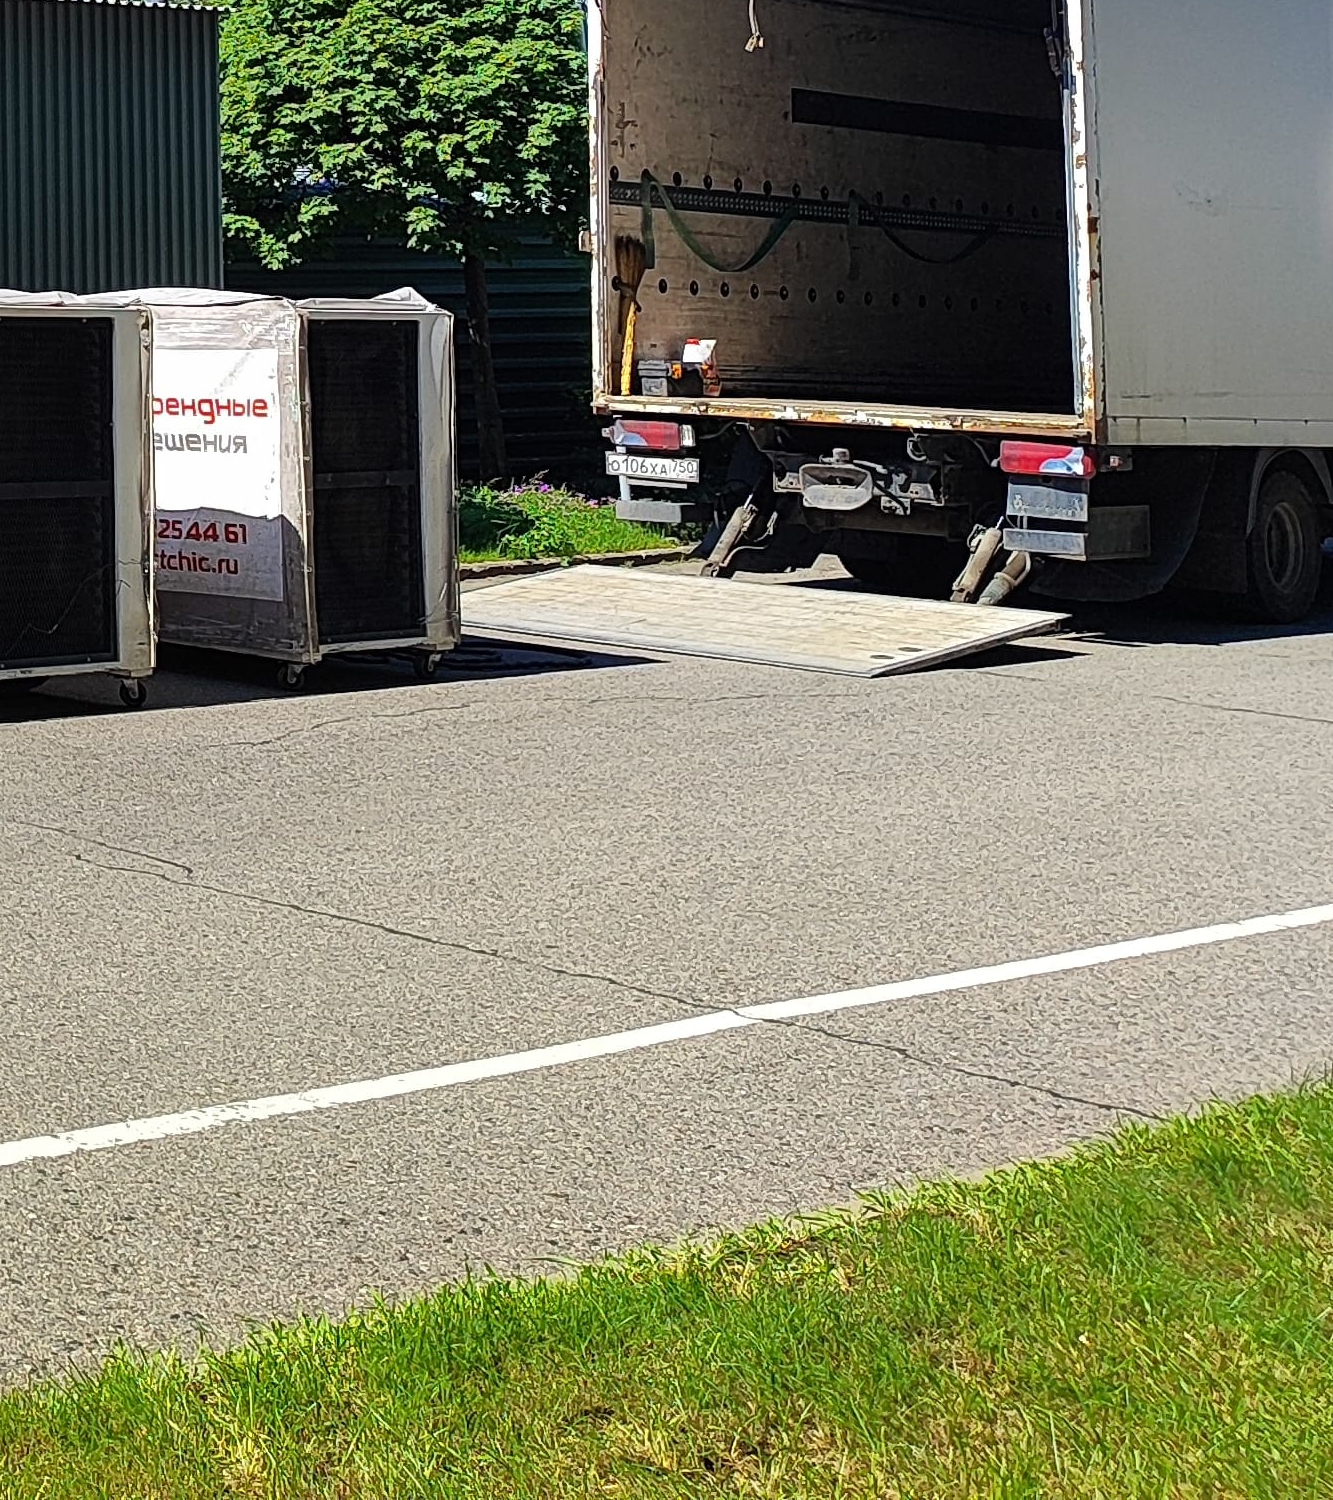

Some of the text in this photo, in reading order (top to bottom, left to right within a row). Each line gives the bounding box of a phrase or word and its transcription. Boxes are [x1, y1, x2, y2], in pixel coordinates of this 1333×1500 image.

[153, 397, 268, 424] рендные
[153, 432, 247, 453] ешения
[156, 519, 247, 545] 25 44 61
[155, 549, 238, 575] tchic.ru
